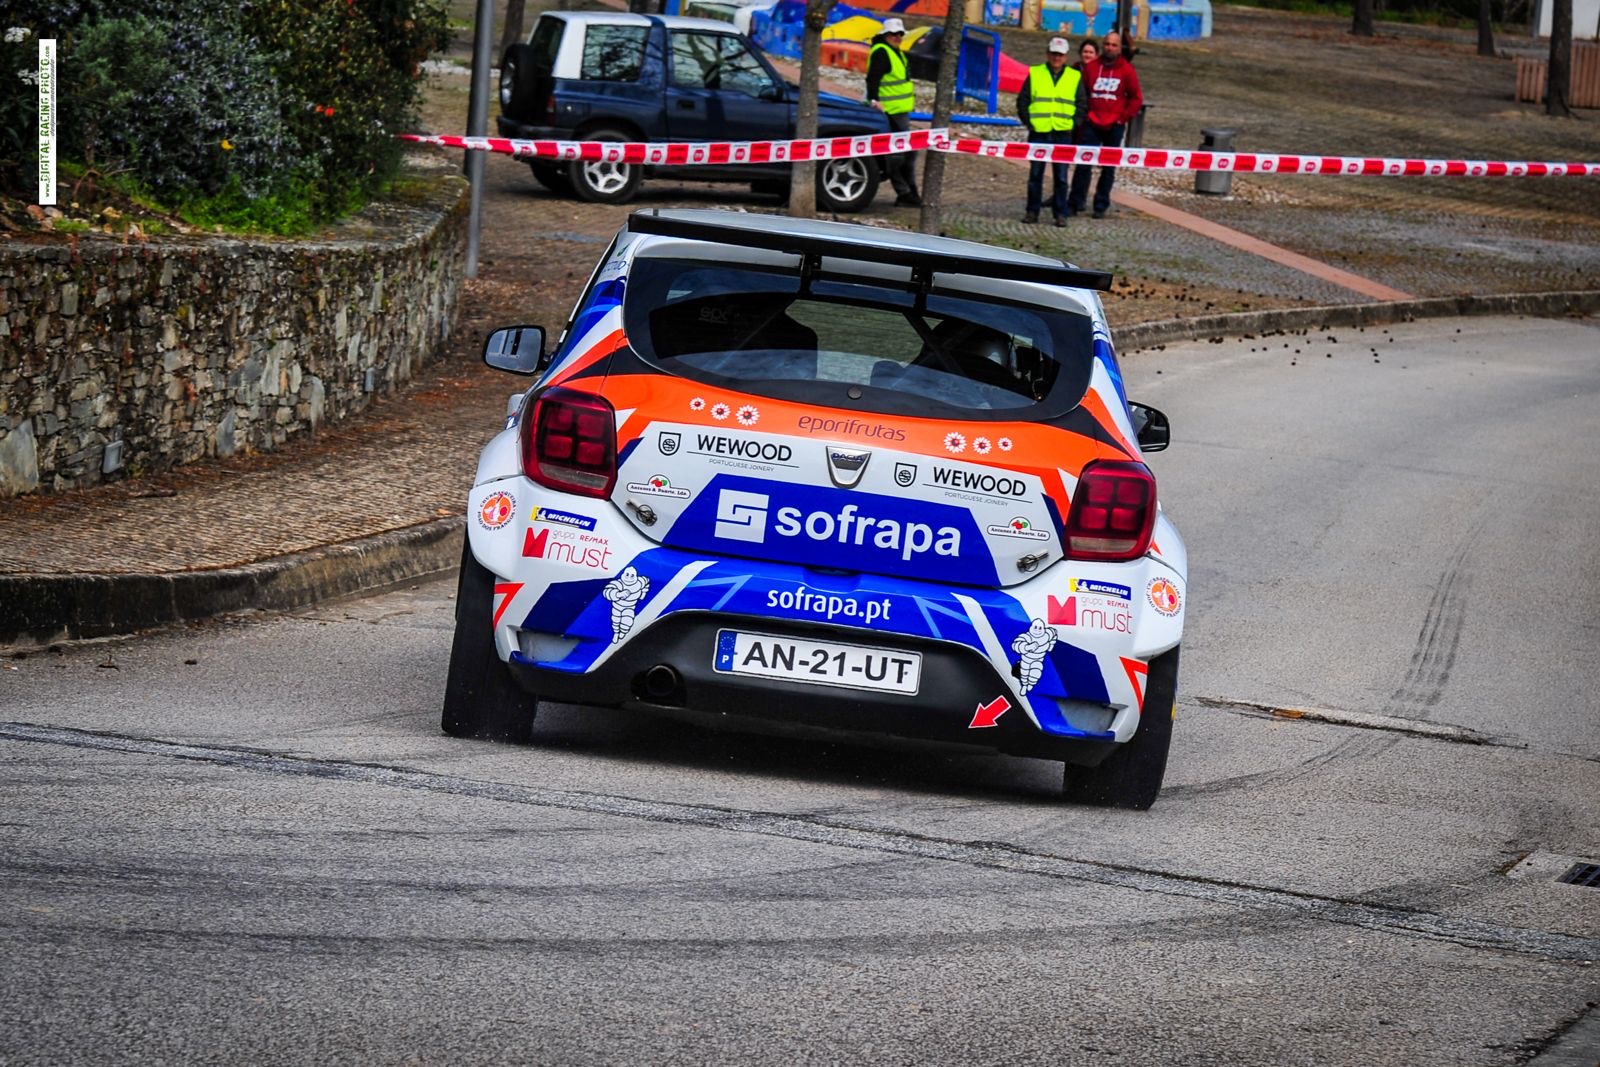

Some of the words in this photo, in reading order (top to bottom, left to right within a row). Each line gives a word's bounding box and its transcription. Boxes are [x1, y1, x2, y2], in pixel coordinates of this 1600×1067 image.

[798, 415, 906, 442] eporifrutas
[697, 434, 793, 462] WEWOOD
[830, 452, 867, 463] DACIA
[708, 458, 748, 470] PORTUGUESE
[748, 464, 775, 473] JOINERY
[933, 466, 1027, 497] WEWOOD
[944, 491, 984, 503] PORTUGUESE
[983, 498, 1010, 508] JOINERY
[547, 513, 592, 528] MICHELIN
[552, 530, 576, 541] grupo
[580, 535, 609, 546] RE/MAX
[775, 504, 963, 562] sofrapa
[547, 541, 613, 571] must
[1089, 584, 1129, 597] MICHELIN
[767, 586, 892, 624] sofrapa.pt
[1081, 596, 1103, 607] grupo
[1107, 599, 1129, 609] RE/MAX
[1081, 609, 1133, 635] must
[721, 654, 730, 664] P
[742, 641, 912, 684] AN-21-UT
